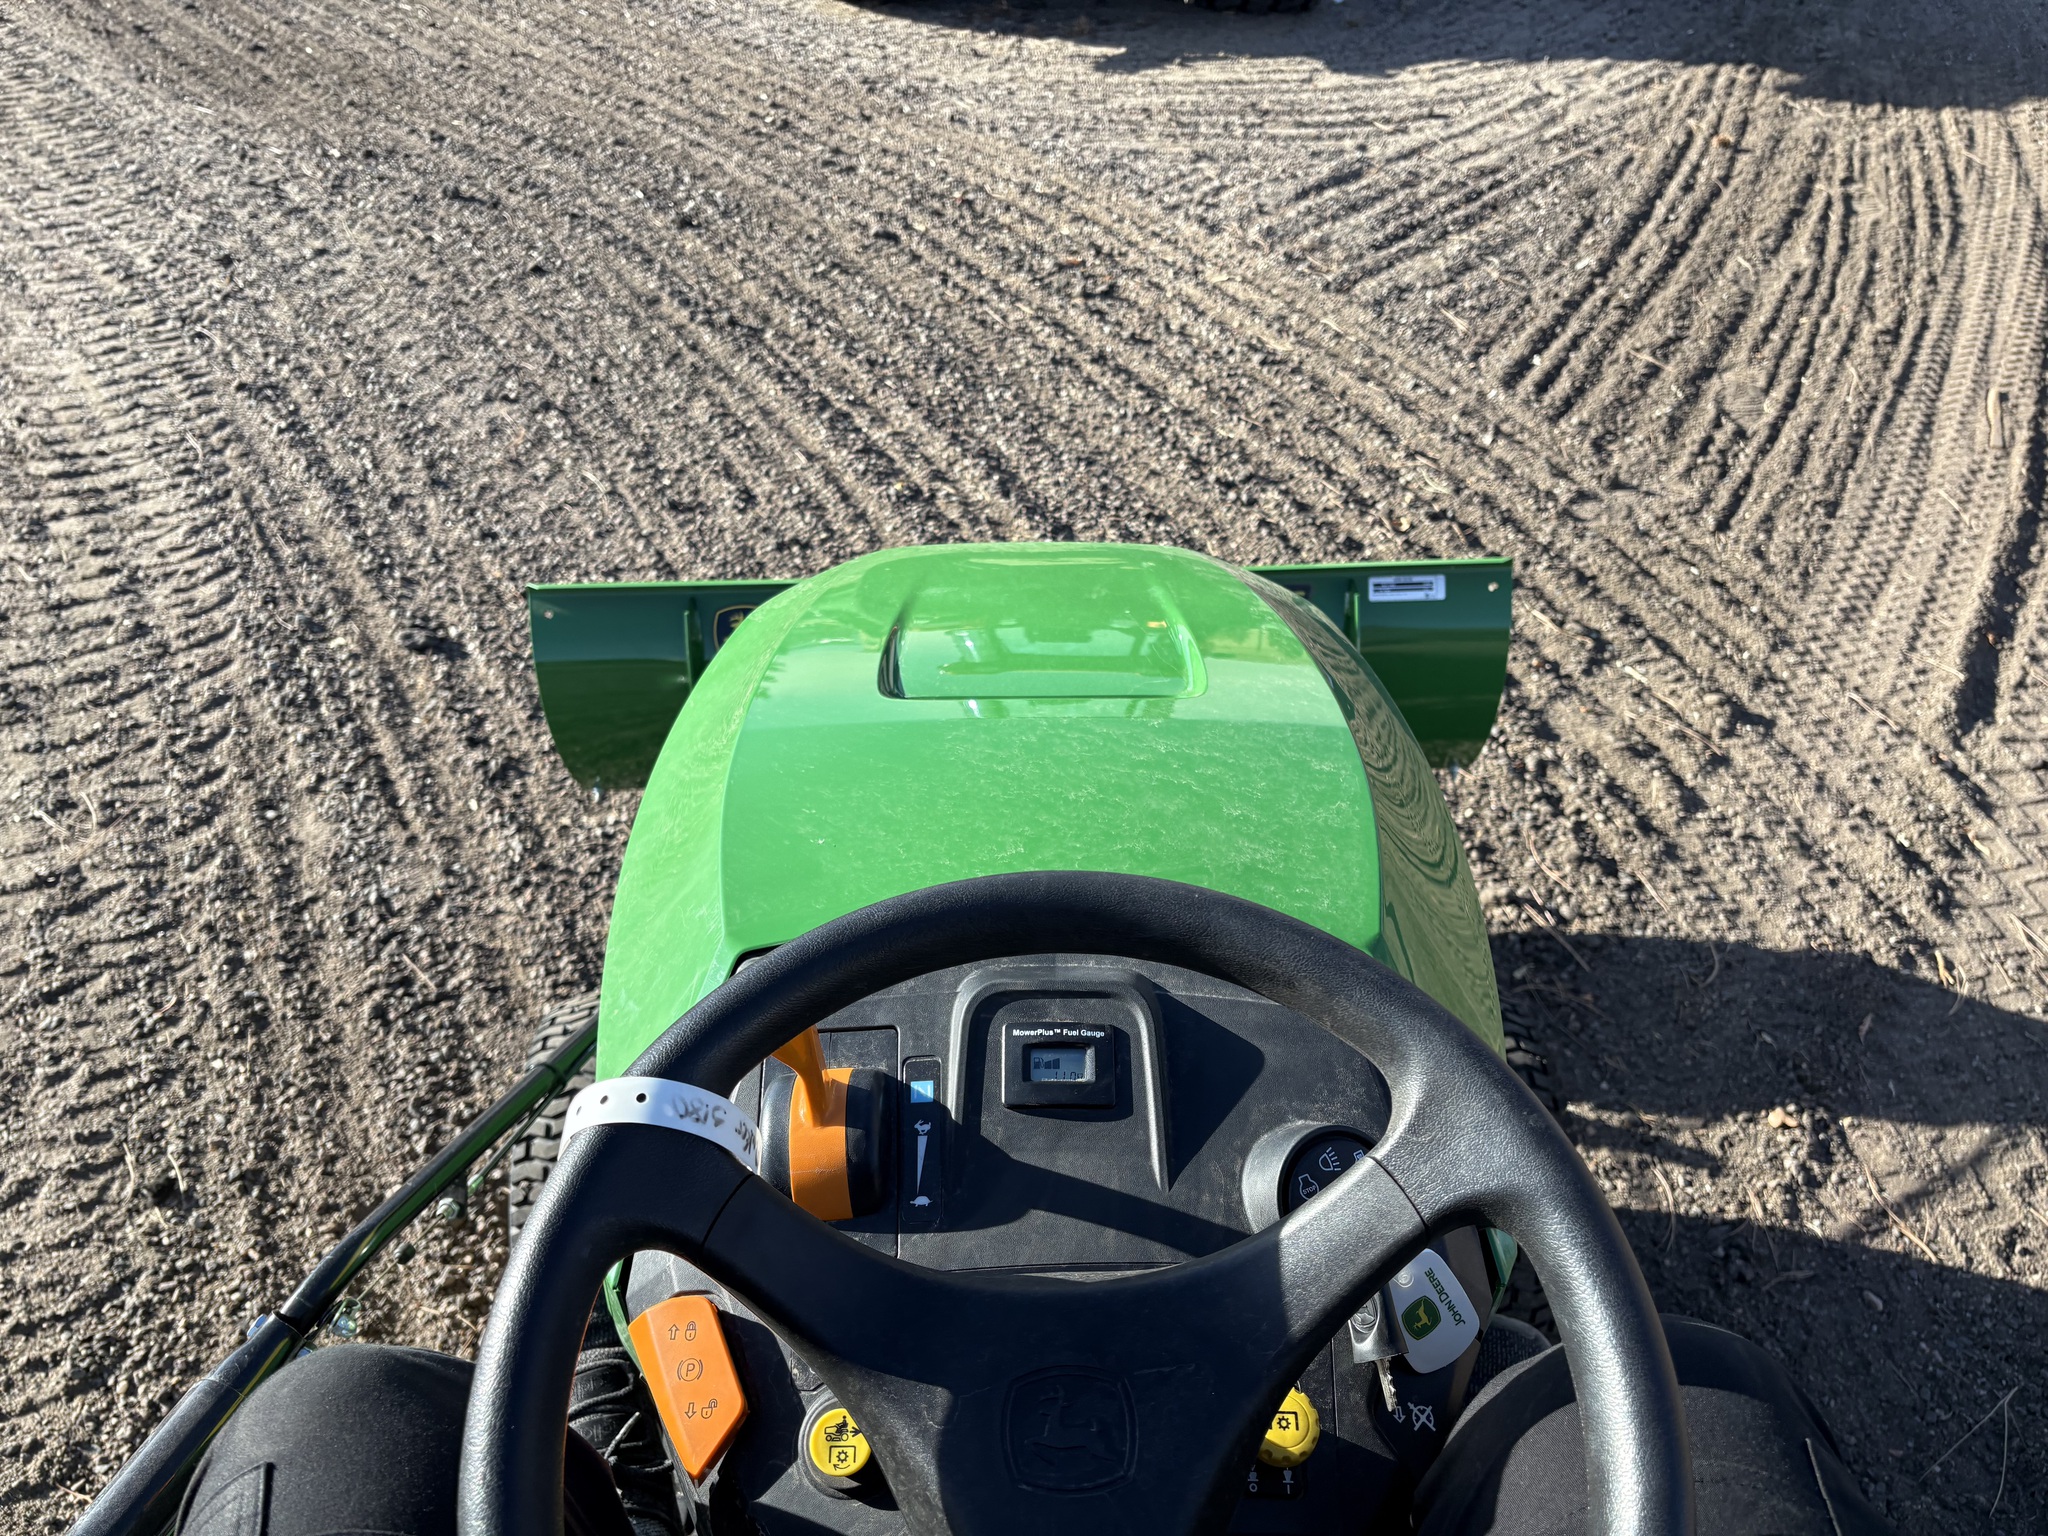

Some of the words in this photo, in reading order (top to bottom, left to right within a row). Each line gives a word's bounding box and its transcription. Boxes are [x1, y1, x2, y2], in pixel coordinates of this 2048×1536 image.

[1080, 1029, 1105, 1038] Gauge
[1303, 1185, 1317, 1195] STOP
[1424, 1267, 1450, 1303] DEERE
[1444, 1299, 1466, 1326] JOHN
